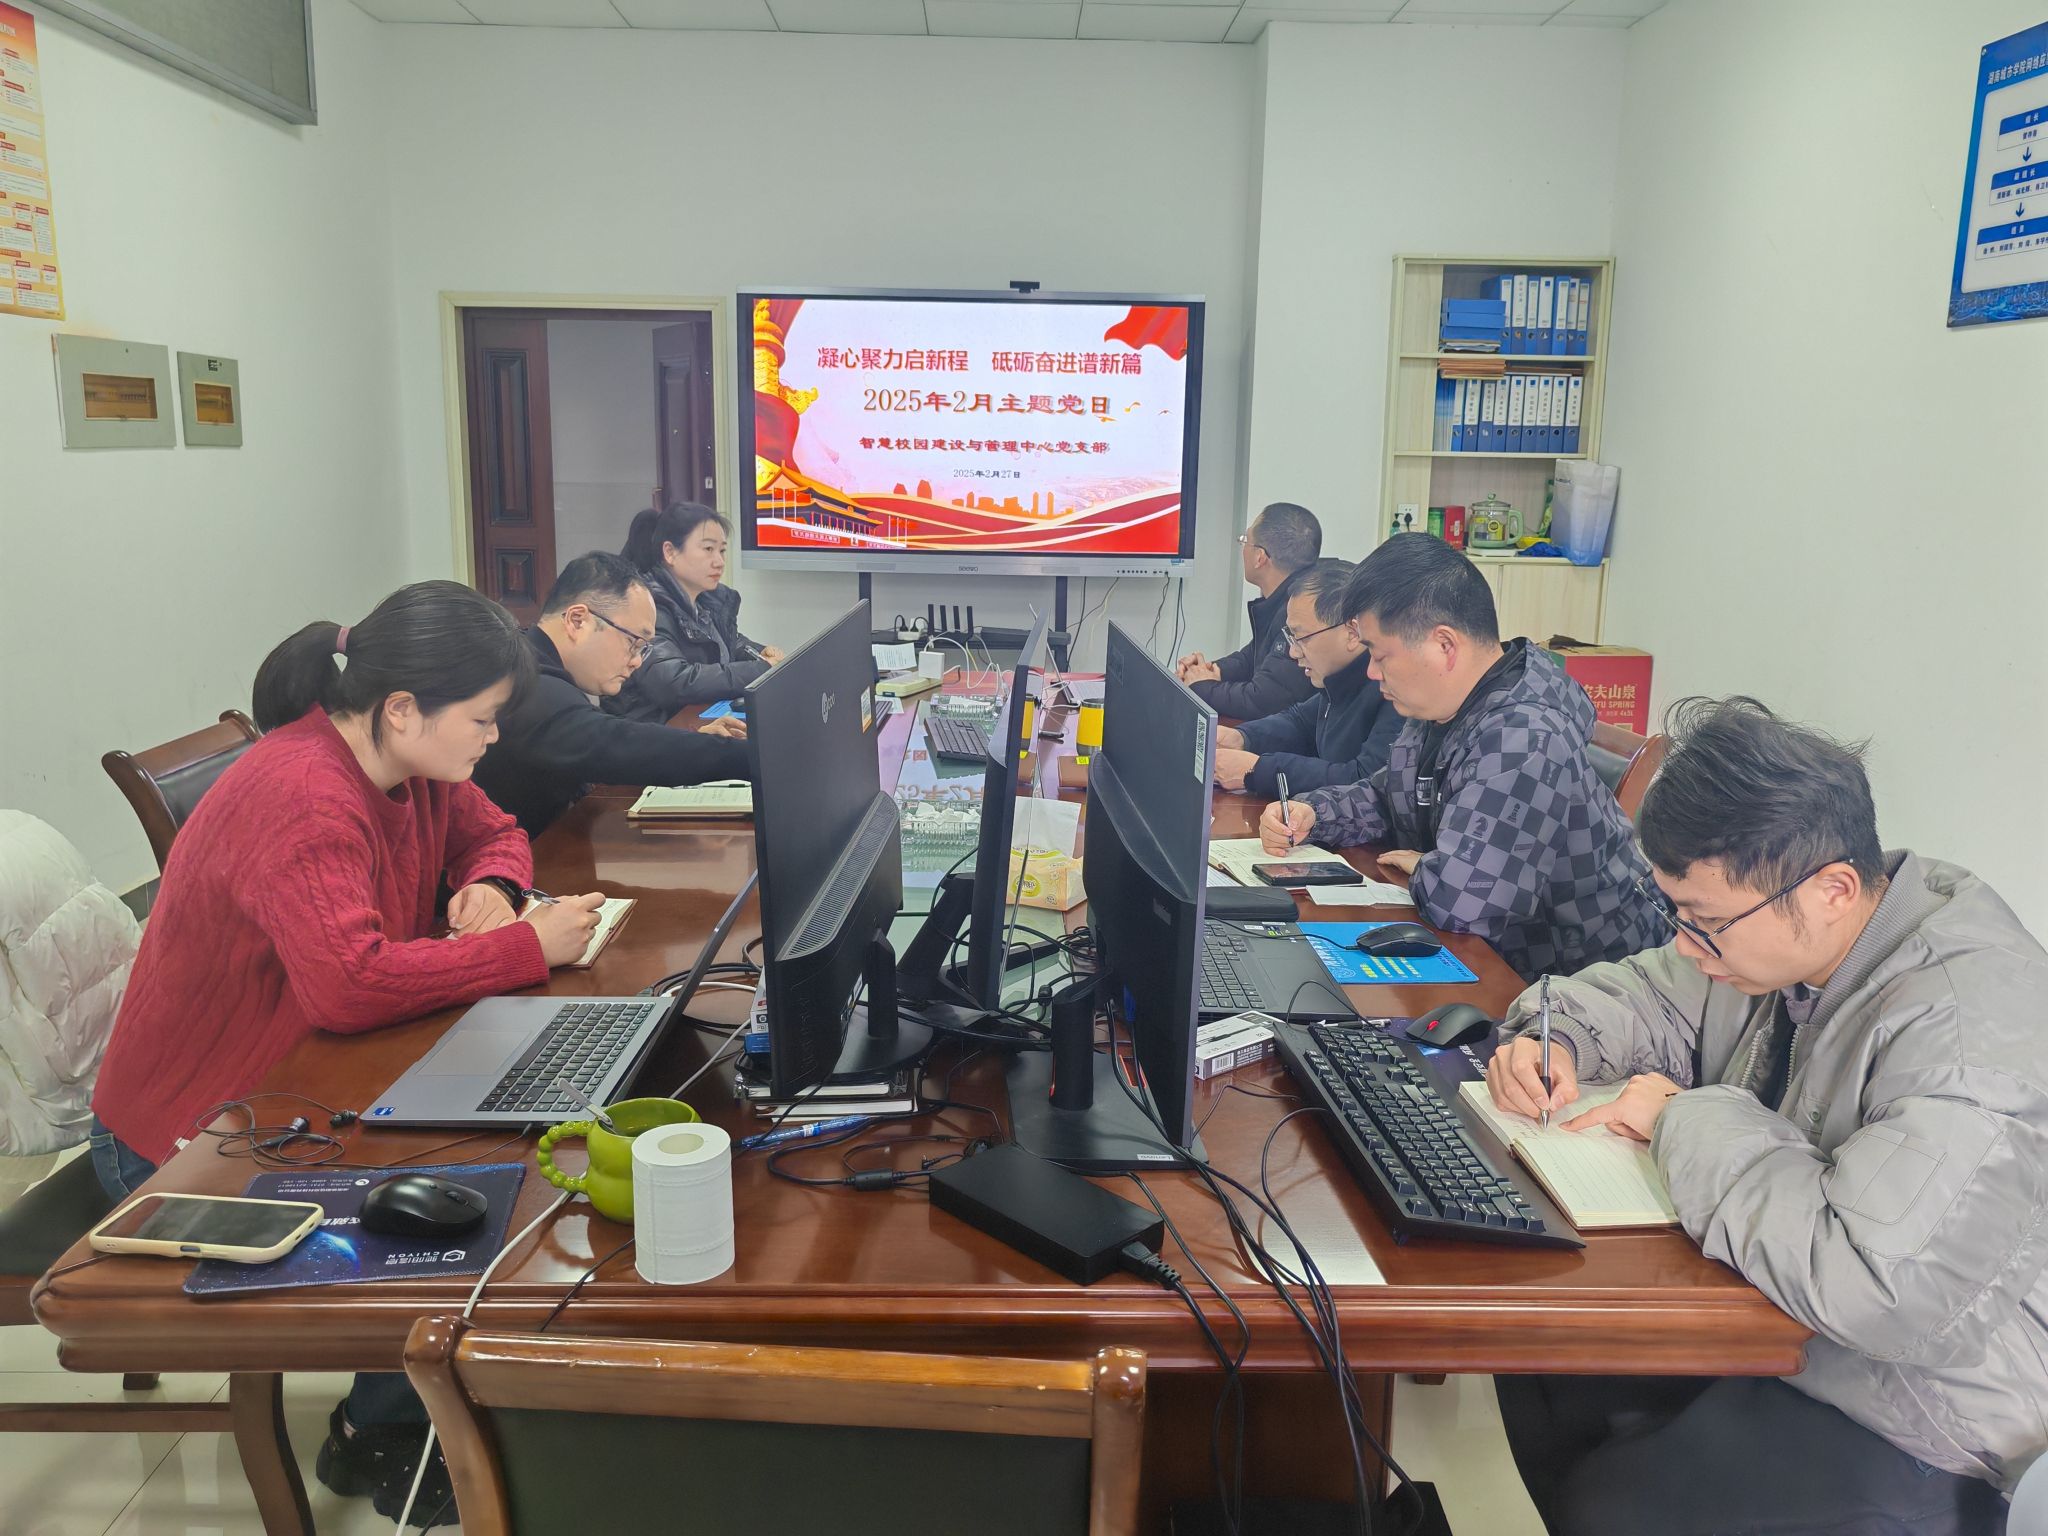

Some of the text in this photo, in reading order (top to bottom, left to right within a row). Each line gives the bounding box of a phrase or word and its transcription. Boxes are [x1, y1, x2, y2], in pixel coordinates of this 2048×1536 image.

[1987, 52, 2048, 85] 湖南城市学院网络应
[817, 346, 1142, 375] 凝心聚力启新程 砥砺奋进谱新篇
[863, 388, 1111, 416] 2025年2月主题党日
[859, 437, 1110, 455] 智慧校园建设与管理中心党支部
[953, 468, 1021, 480] 2025年2月27日
